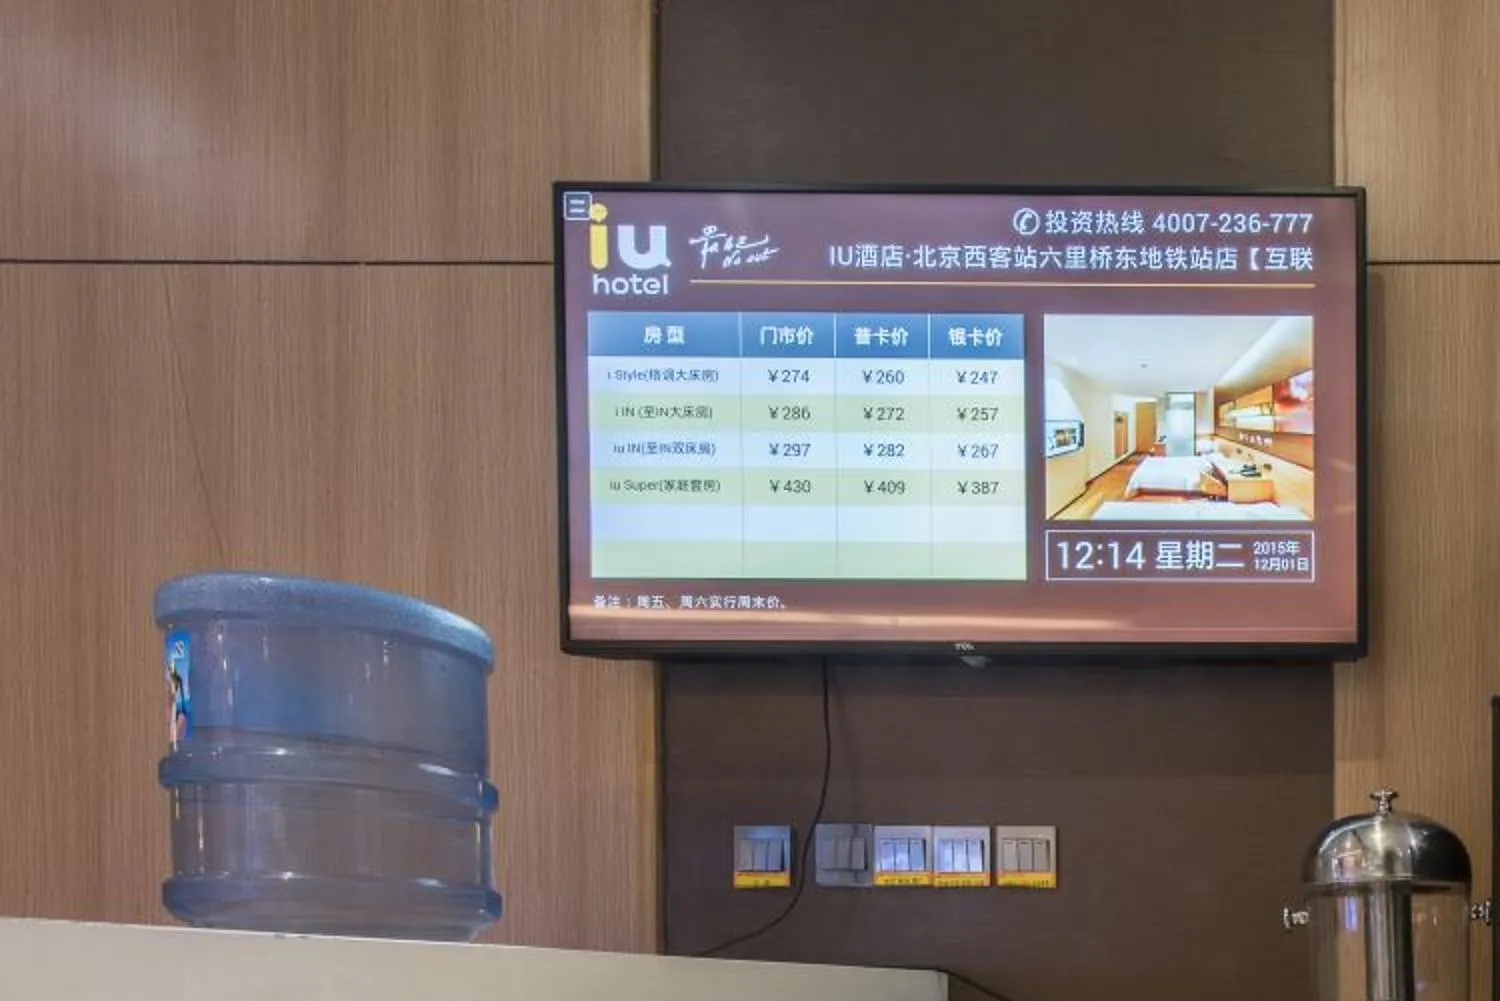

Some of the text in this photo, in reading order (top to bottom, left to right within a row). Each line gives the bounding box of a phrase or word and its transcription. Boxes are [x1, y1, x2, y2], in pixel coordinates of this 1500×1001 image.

[1045, 209, 1314, 235] 投资热线 4007-236-777
[592, 273, 670, 296] hotel
[760, 326, 814, 346] 门市价
[854, 327, 909, 346] 普卡价
[948, 327, 1004, 347] 银卡价
[1056, 540, 1301, 571] 12:14 星期二 2015年
[1253, 558, 1310, 571] 12月01日
